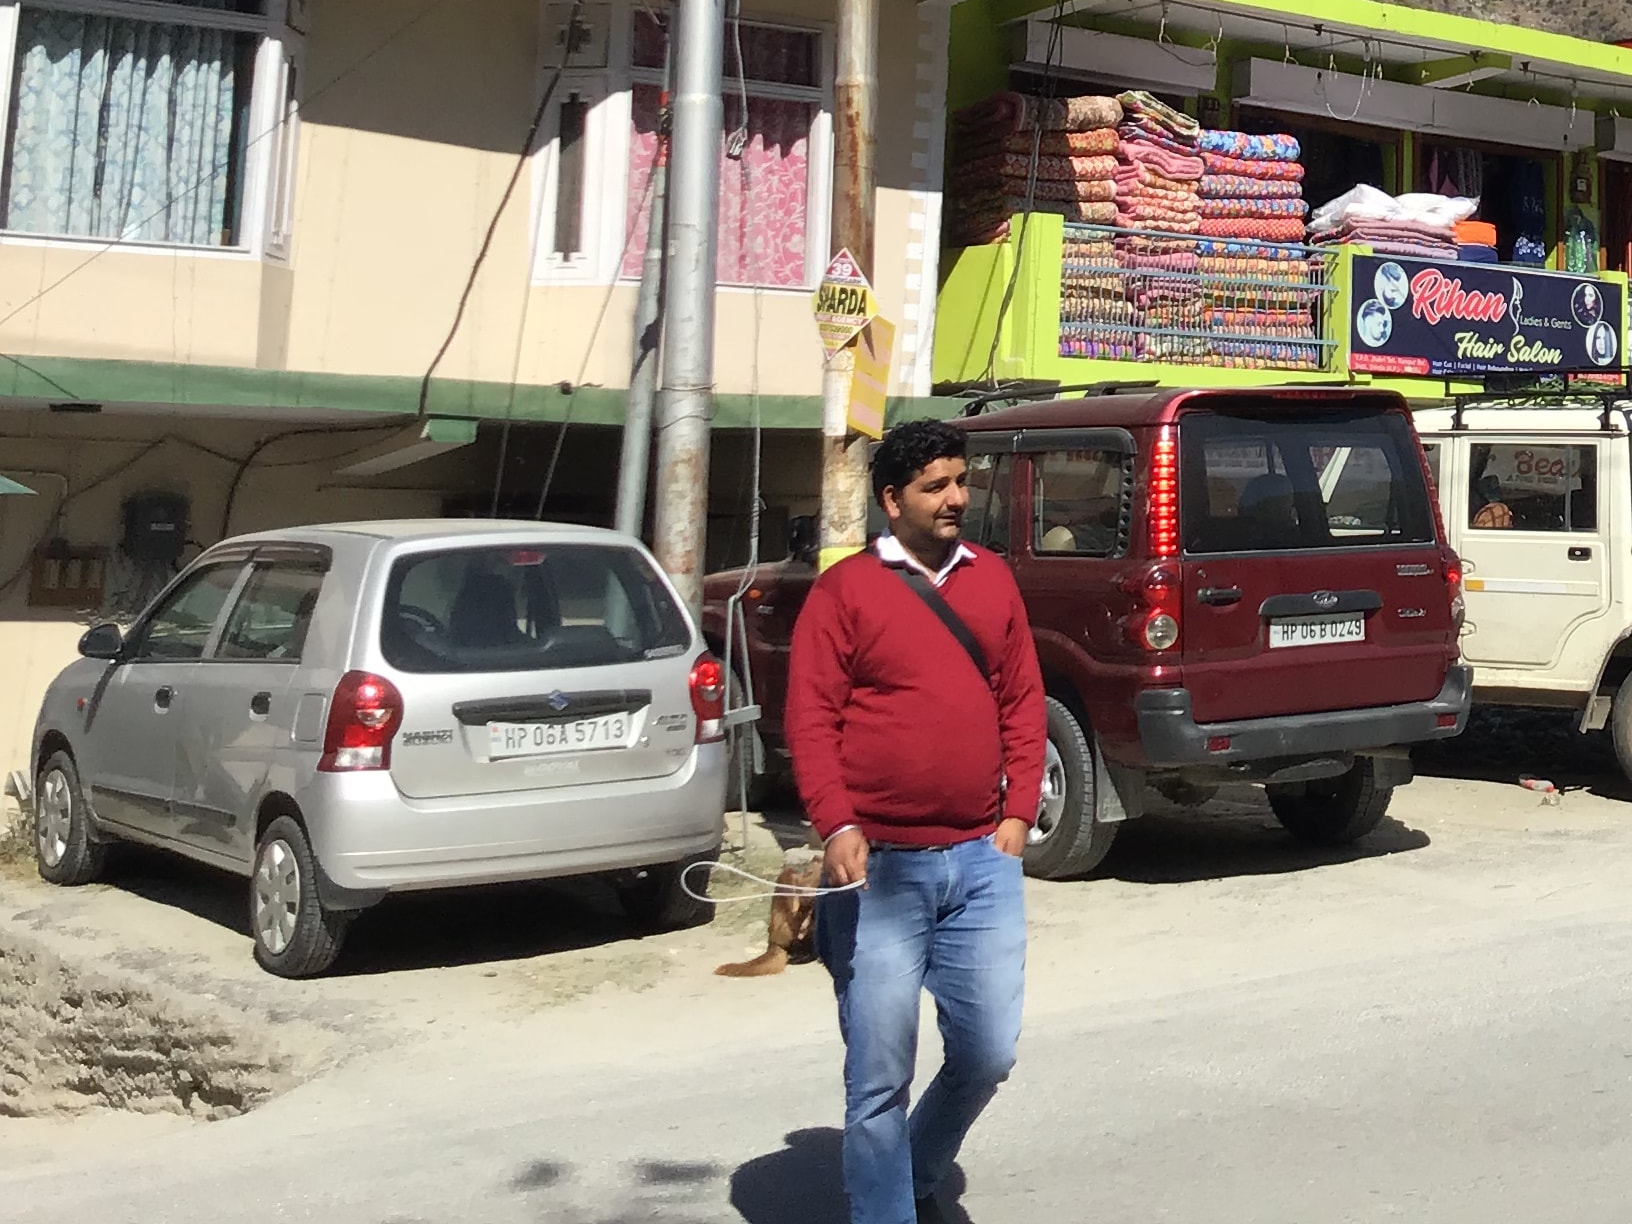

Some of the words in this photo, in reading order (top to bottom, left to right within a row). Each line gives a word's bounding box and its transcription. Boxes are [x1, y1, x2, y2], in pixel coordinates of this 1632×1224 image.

[831, 262, 853, 276] 39
[817, 285, 867, 316] SHARDA
[1411, 269, 1507, 325] Rihan
[1520, 316, 1543, 327] Ladies
[1544, 317, 1549, 327] &
[1551, 318, 1572, 329] Gents
[1454, 331, 1505, 359] Hair
[1507, 334, 1562, 365] Salon
[1281, 623, 1297, 641] HP
[1301, 622, 1316, 639] 06
[1319, 621, 1326, 638] B
[1330, 620, 1362, 638] 0249
[504, 726, 527, 749] HP
[575, 718, 625, 743] 5713
